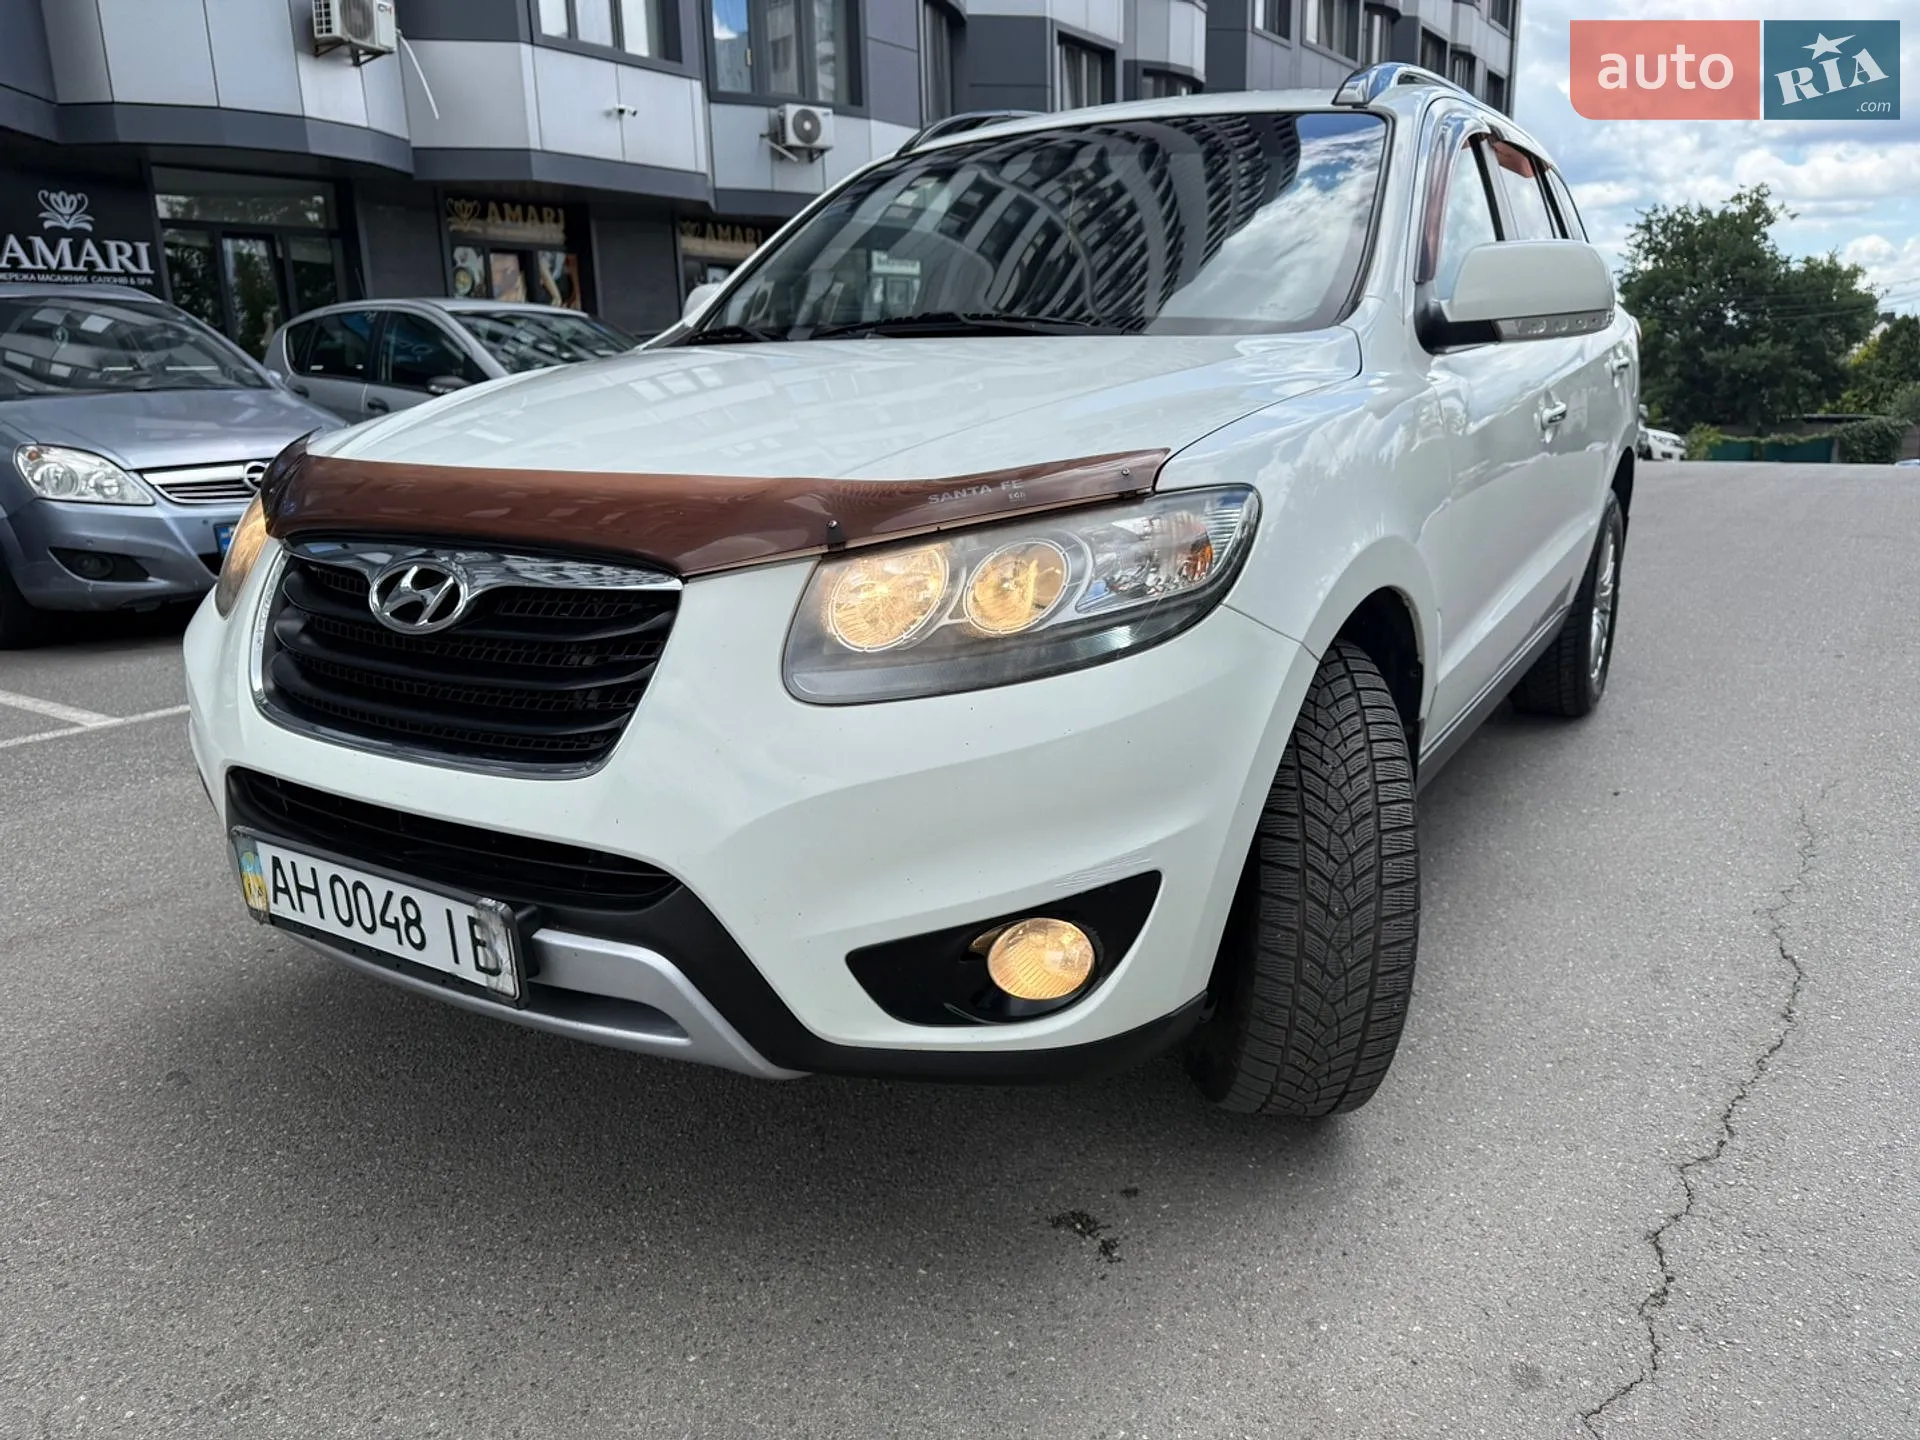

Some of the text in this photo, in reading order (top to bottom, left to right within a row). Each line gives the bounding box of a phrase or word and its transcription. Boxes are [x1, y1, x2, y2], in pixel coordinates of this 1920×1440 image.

[487, 201, 565, 229] AMARI
[0, 233, 155, 274] AMARI
[928, 479, 1024, 505] SANTA FE
